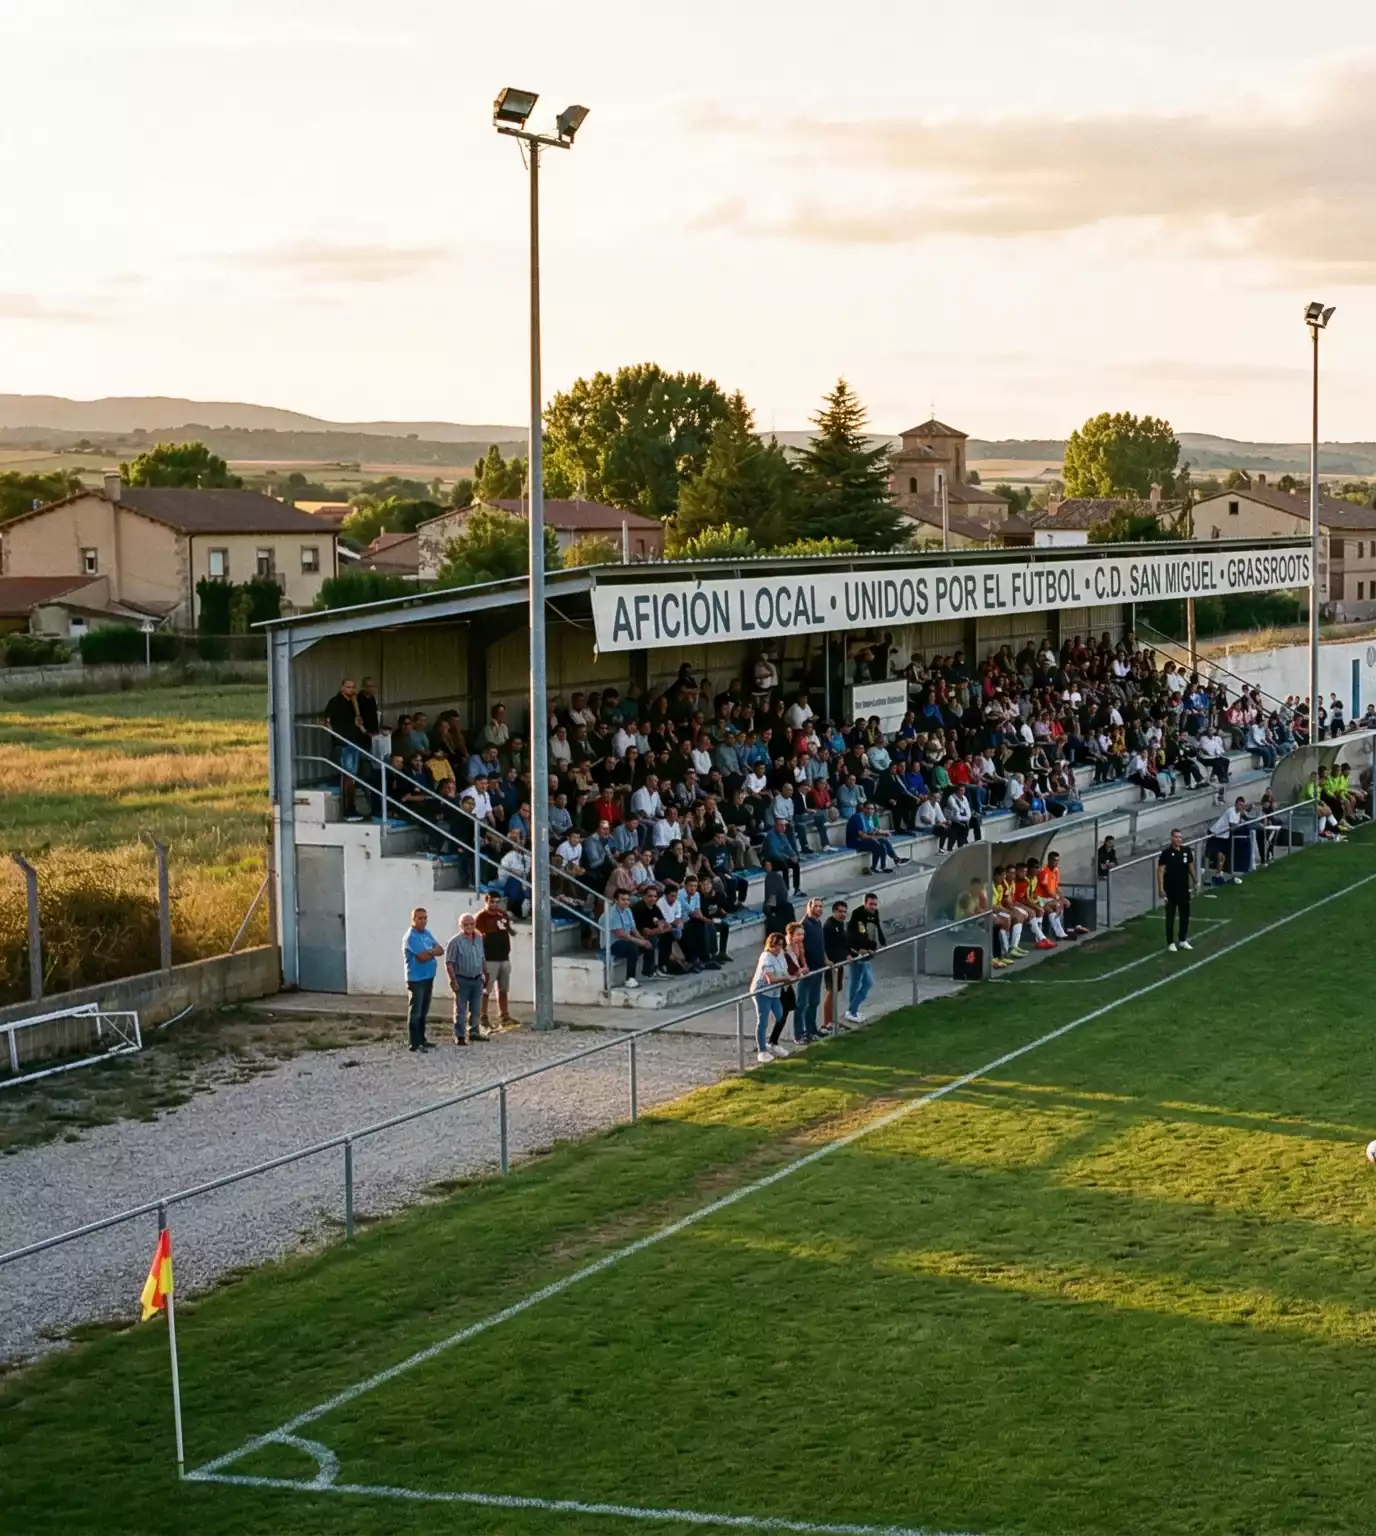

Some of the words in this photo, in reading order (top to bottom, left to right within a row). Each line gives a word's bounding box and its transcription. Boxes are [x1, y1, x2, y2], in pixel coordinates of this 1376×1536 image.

[612, 580, 731, 643] AFICIÓN
[739, 585, 825, 632] LOCAL
[844, 577, 929, 622] UNIDOS
[935, 574, 978, 614] POR
[983, 573, 1007, 609] EL
[1094, 565, 1127, 600] C.D.
[1129, 563, 1161, 597] SAN
[1165, 560, 1218, 594] MIGUEL
[1227, 553, 1310, 588] GRASSROOTS
